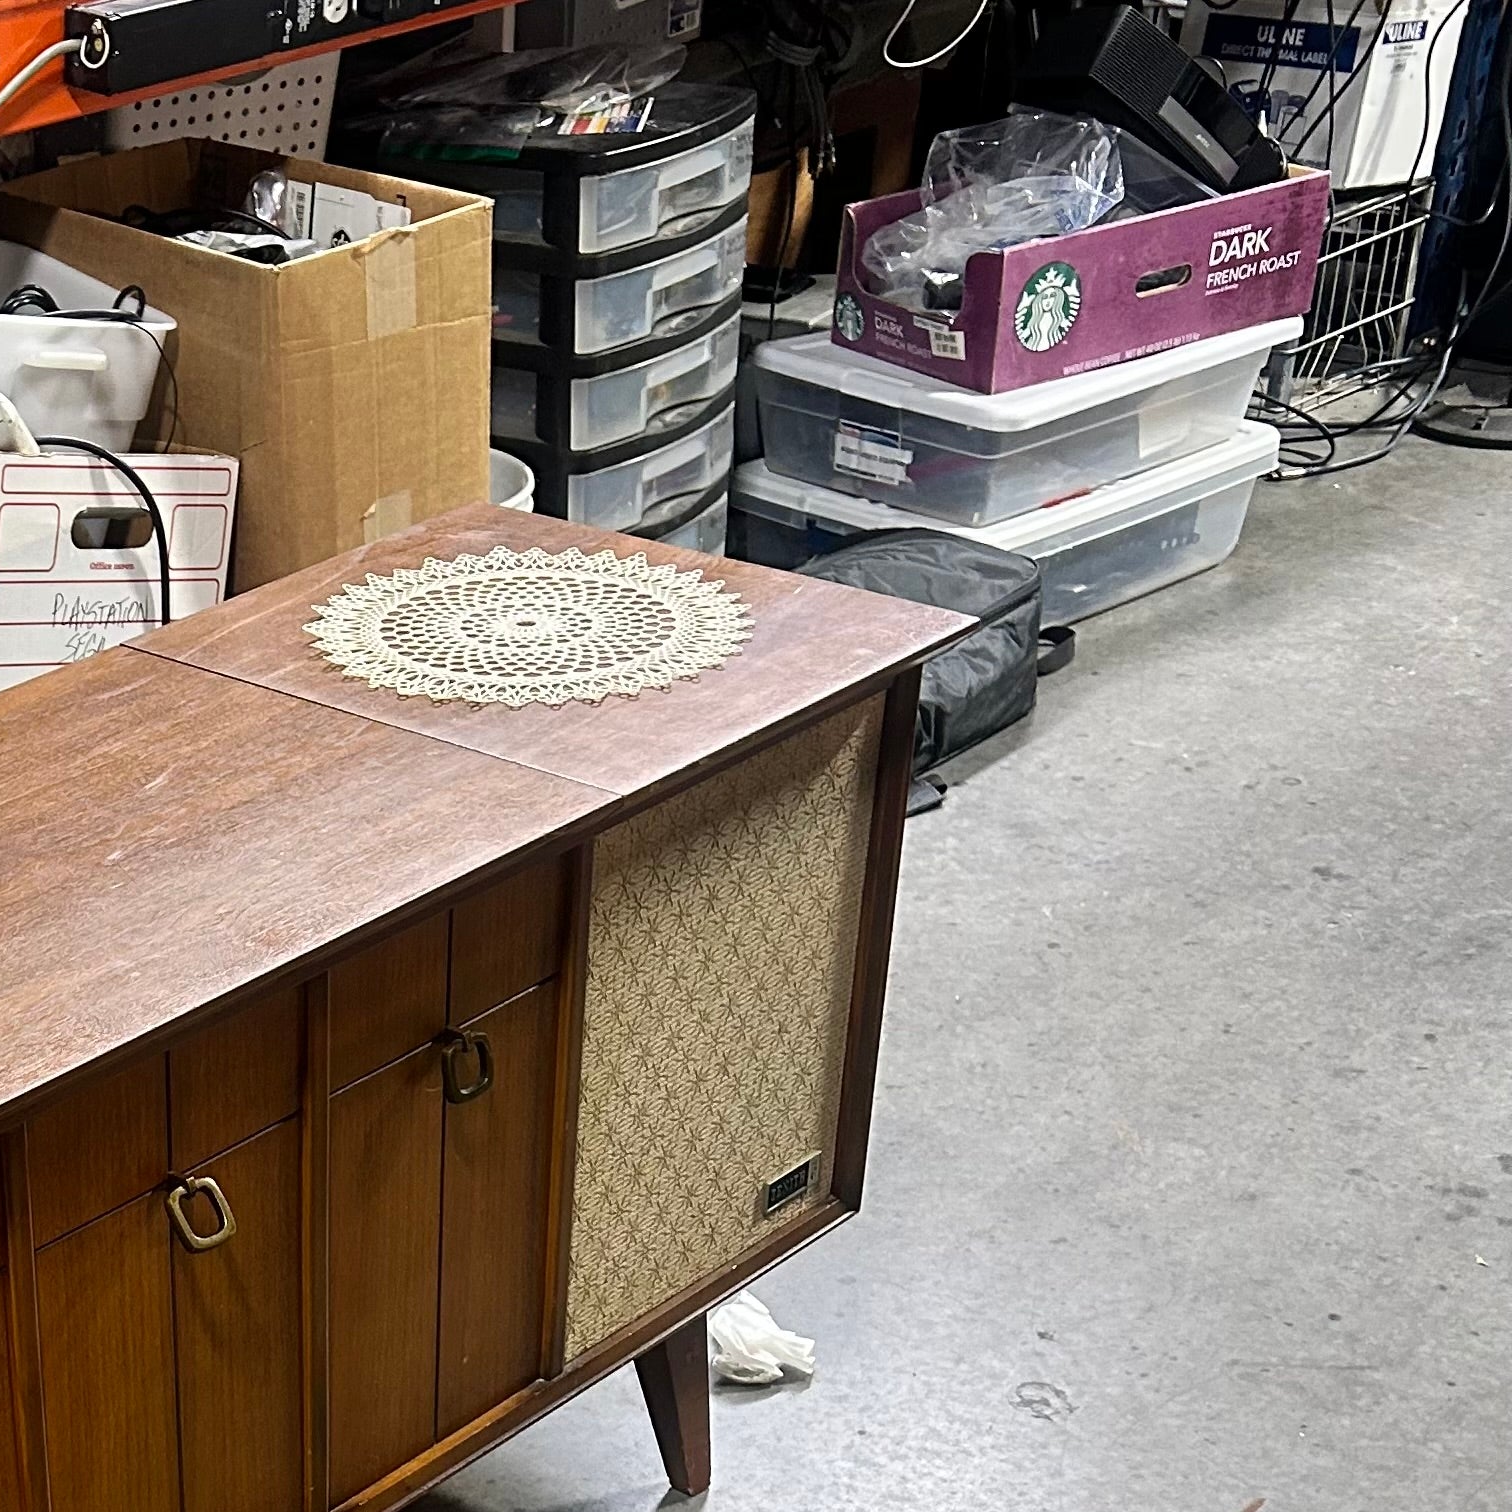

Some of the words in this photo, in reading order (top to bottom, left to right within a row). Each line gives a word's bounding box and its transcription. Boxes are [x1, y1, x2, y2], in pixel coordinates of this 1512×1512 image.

[1257, 25, 1306, 46] ULNE
[1388, 21, 1424, 42] ULINE
[1209, 226, 1272, 267] DARK
[1206, 262, 1257, 288] FRENCH
[1258, 250, 1302, 275] ROAST
